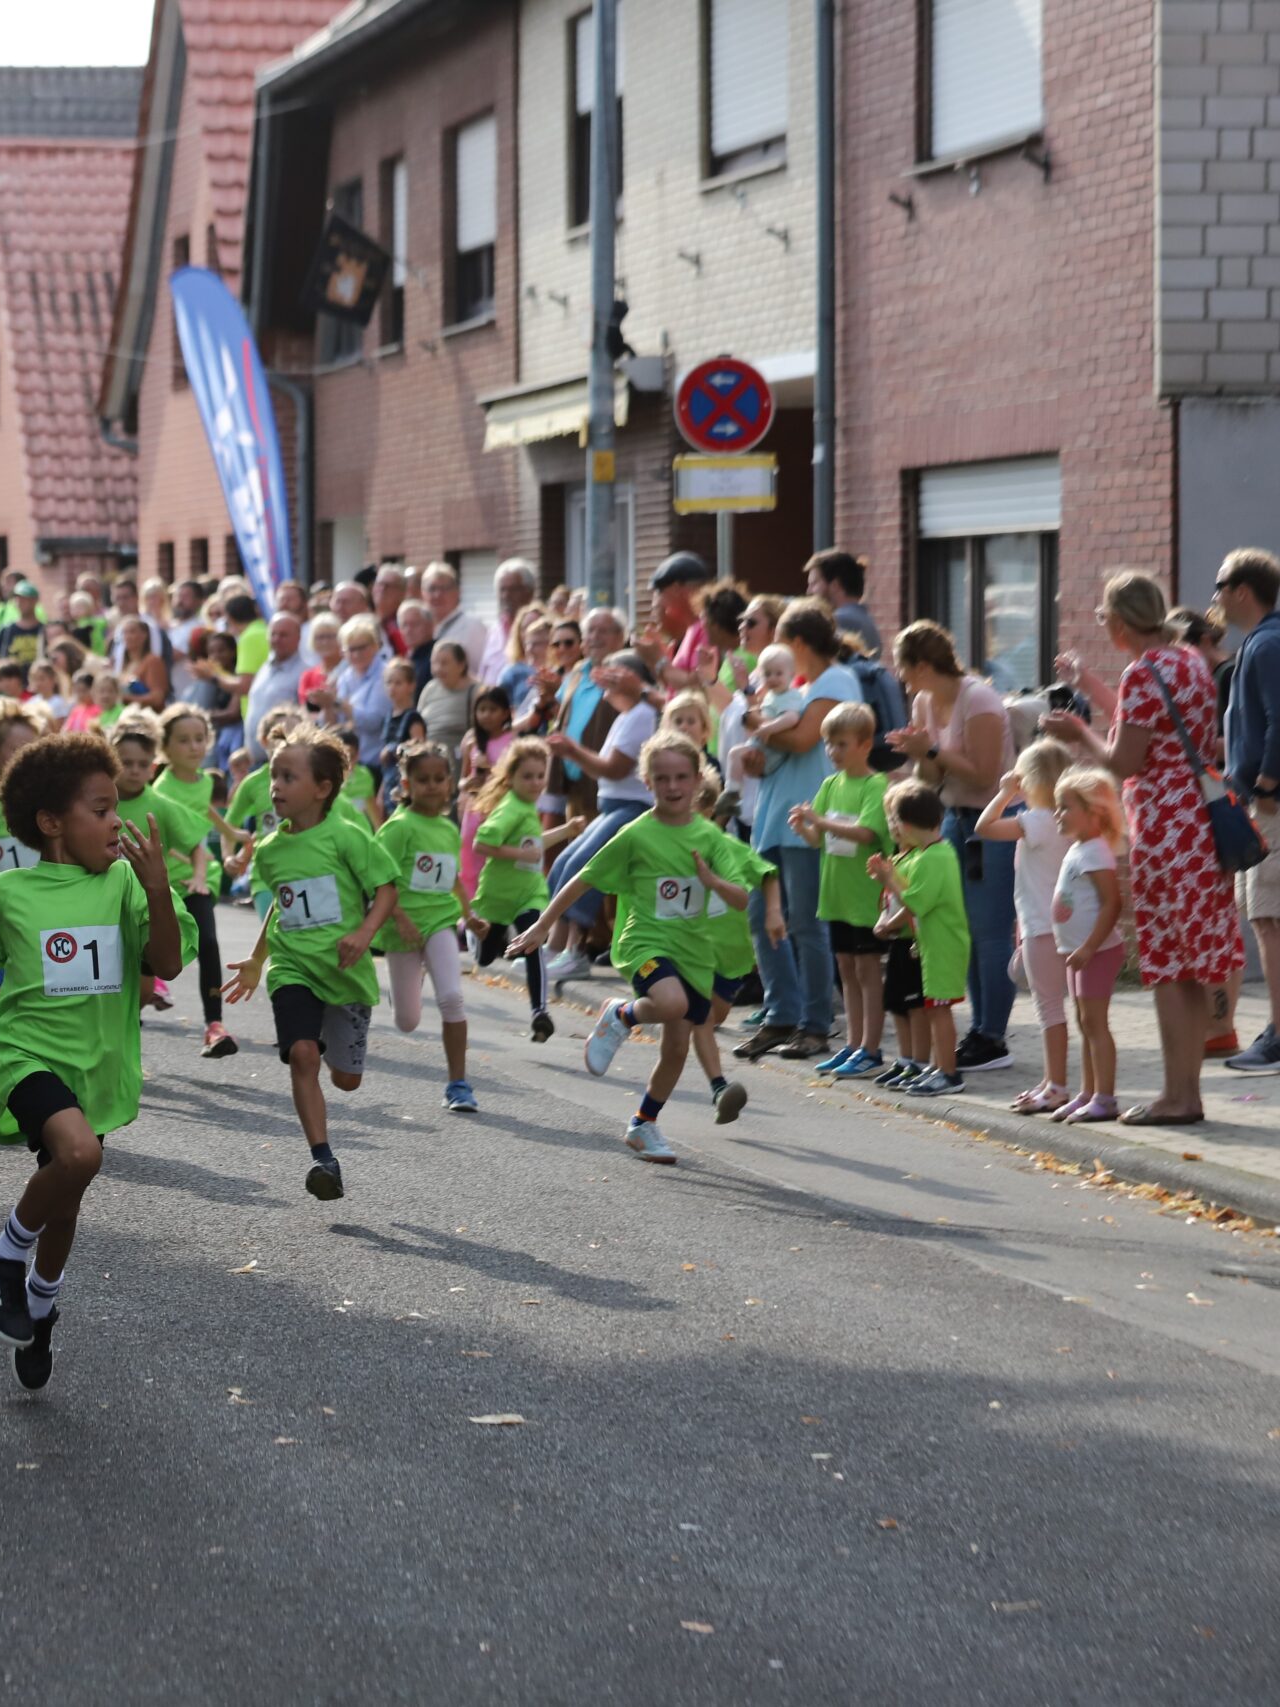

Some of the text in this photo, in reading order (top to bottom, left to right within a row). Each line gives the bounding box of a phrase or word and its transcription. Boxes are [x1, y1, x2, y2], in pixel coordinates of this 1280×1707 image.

[7, 845, 20, 868] 1
[297, 890, 311, 918] 1
[681, 885, 692, 911] 1
[53, 938, 70, 957] FC
[83, 939, 100, 980] 1
